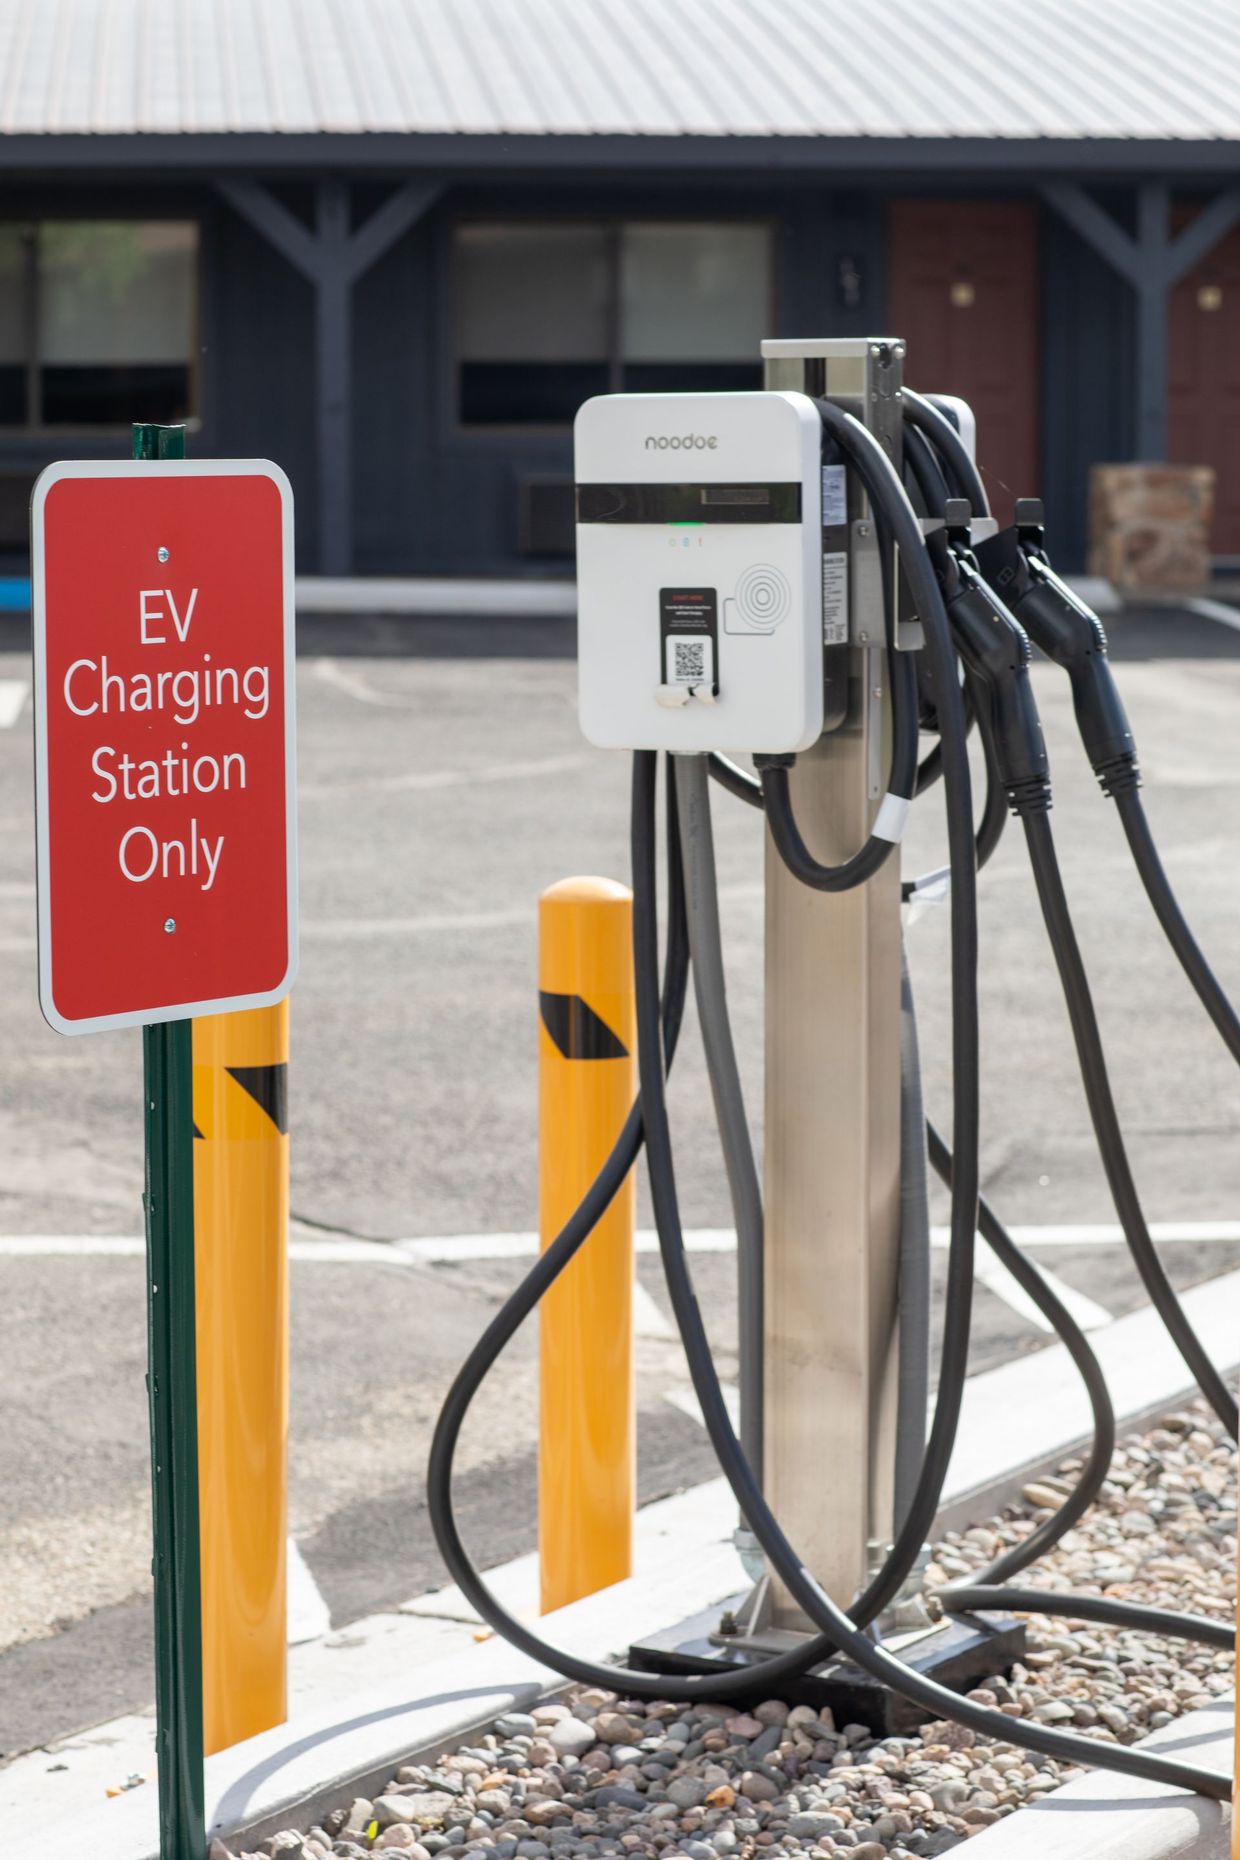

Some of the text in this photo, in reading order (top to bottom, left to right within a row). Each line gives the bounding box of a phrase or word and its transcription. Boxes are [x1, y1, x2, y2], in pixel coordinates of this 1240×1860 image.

[645, 433, 718, 450] noodoe
[139, 588, 199, 645] EV
[63, 654, 270, 725] Charging
[91, 742, 246, 804] Station
[118, 819, 225, 891] Only
